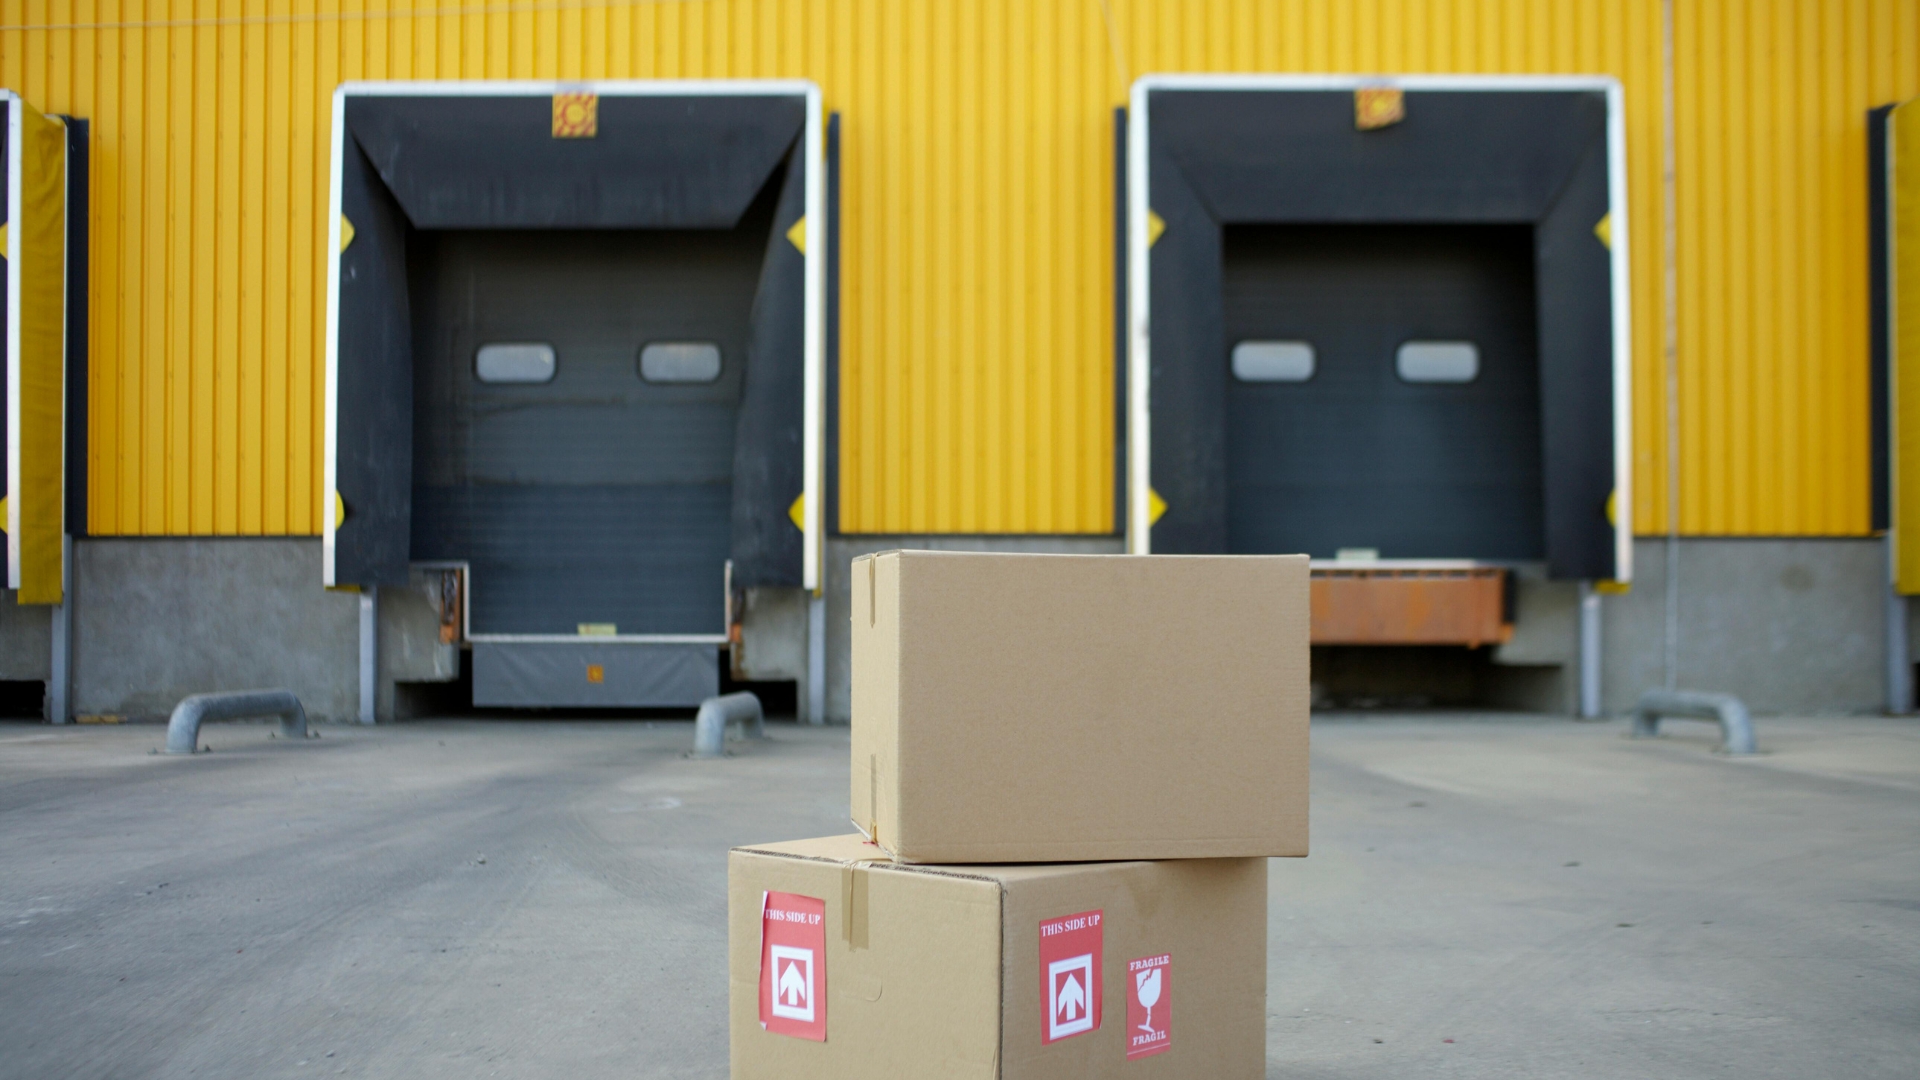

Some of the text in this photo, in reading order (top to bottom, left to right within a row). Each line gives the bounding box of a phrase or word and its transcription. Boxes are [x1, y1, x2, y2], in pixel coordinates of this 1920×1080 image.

[786, 911, 807, 923] SIDE
[808, 913, 821, 925] UP
[1041, 914, 1100, 937] THIS SIDE UP
[1130, 955, 1169, 971] FRAGILE
[1133, 1030, 1166, 1046] FRAGIL
